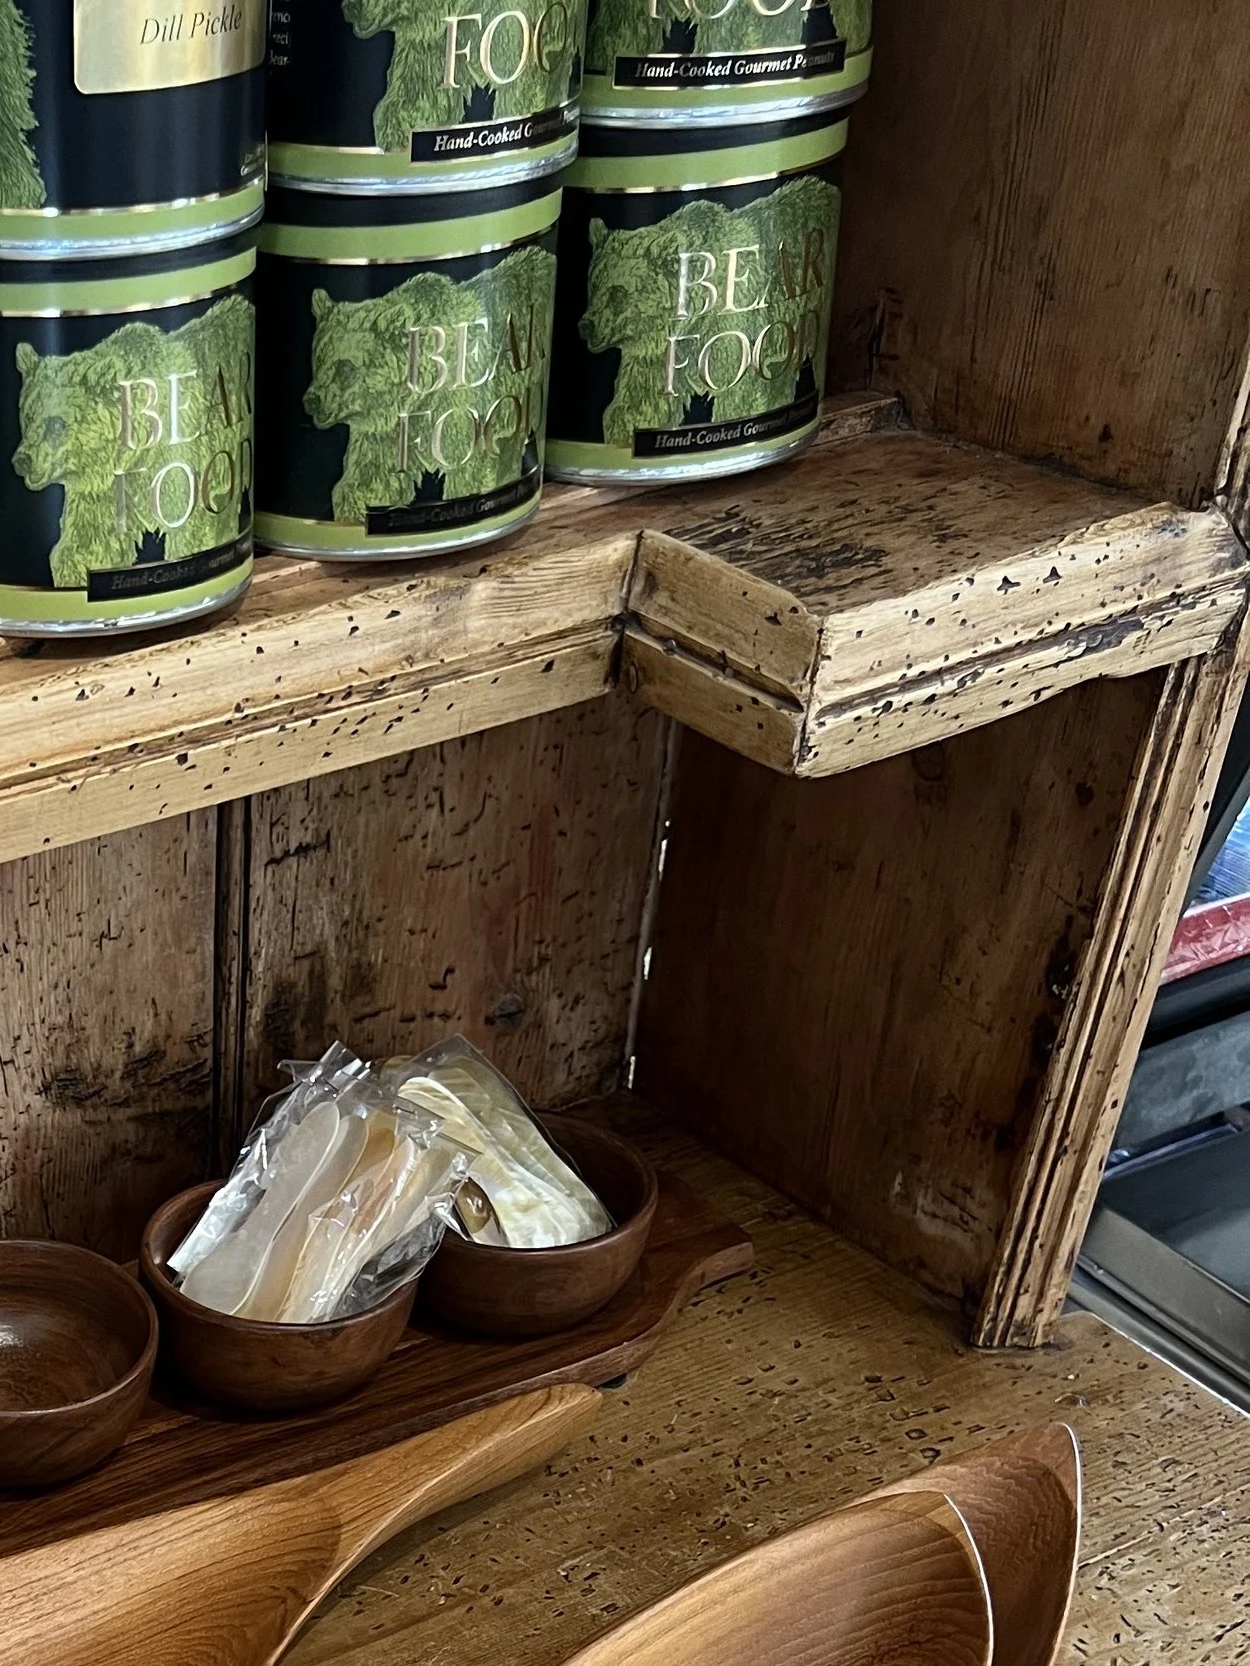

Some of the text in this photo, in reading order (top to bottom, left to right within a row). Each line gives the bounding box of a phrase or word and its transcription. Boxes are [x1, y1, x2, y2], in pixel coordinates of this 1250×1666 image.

[140, 18, 183, 46] Dill
[189, 9, 243, 40] Pickle
[438, 3, 577, 91] FOO
[635, 58, 731, 79] Hand-Cooked
[734, 55, 792, 76] Gourmet
[434, 124, 523, 152] Hand-Cooked
[675, 227, 826, 320] BEAR
[662, 309, 820, 398] FOOD
[655, 425, 742, 450] Hand-Cooked
